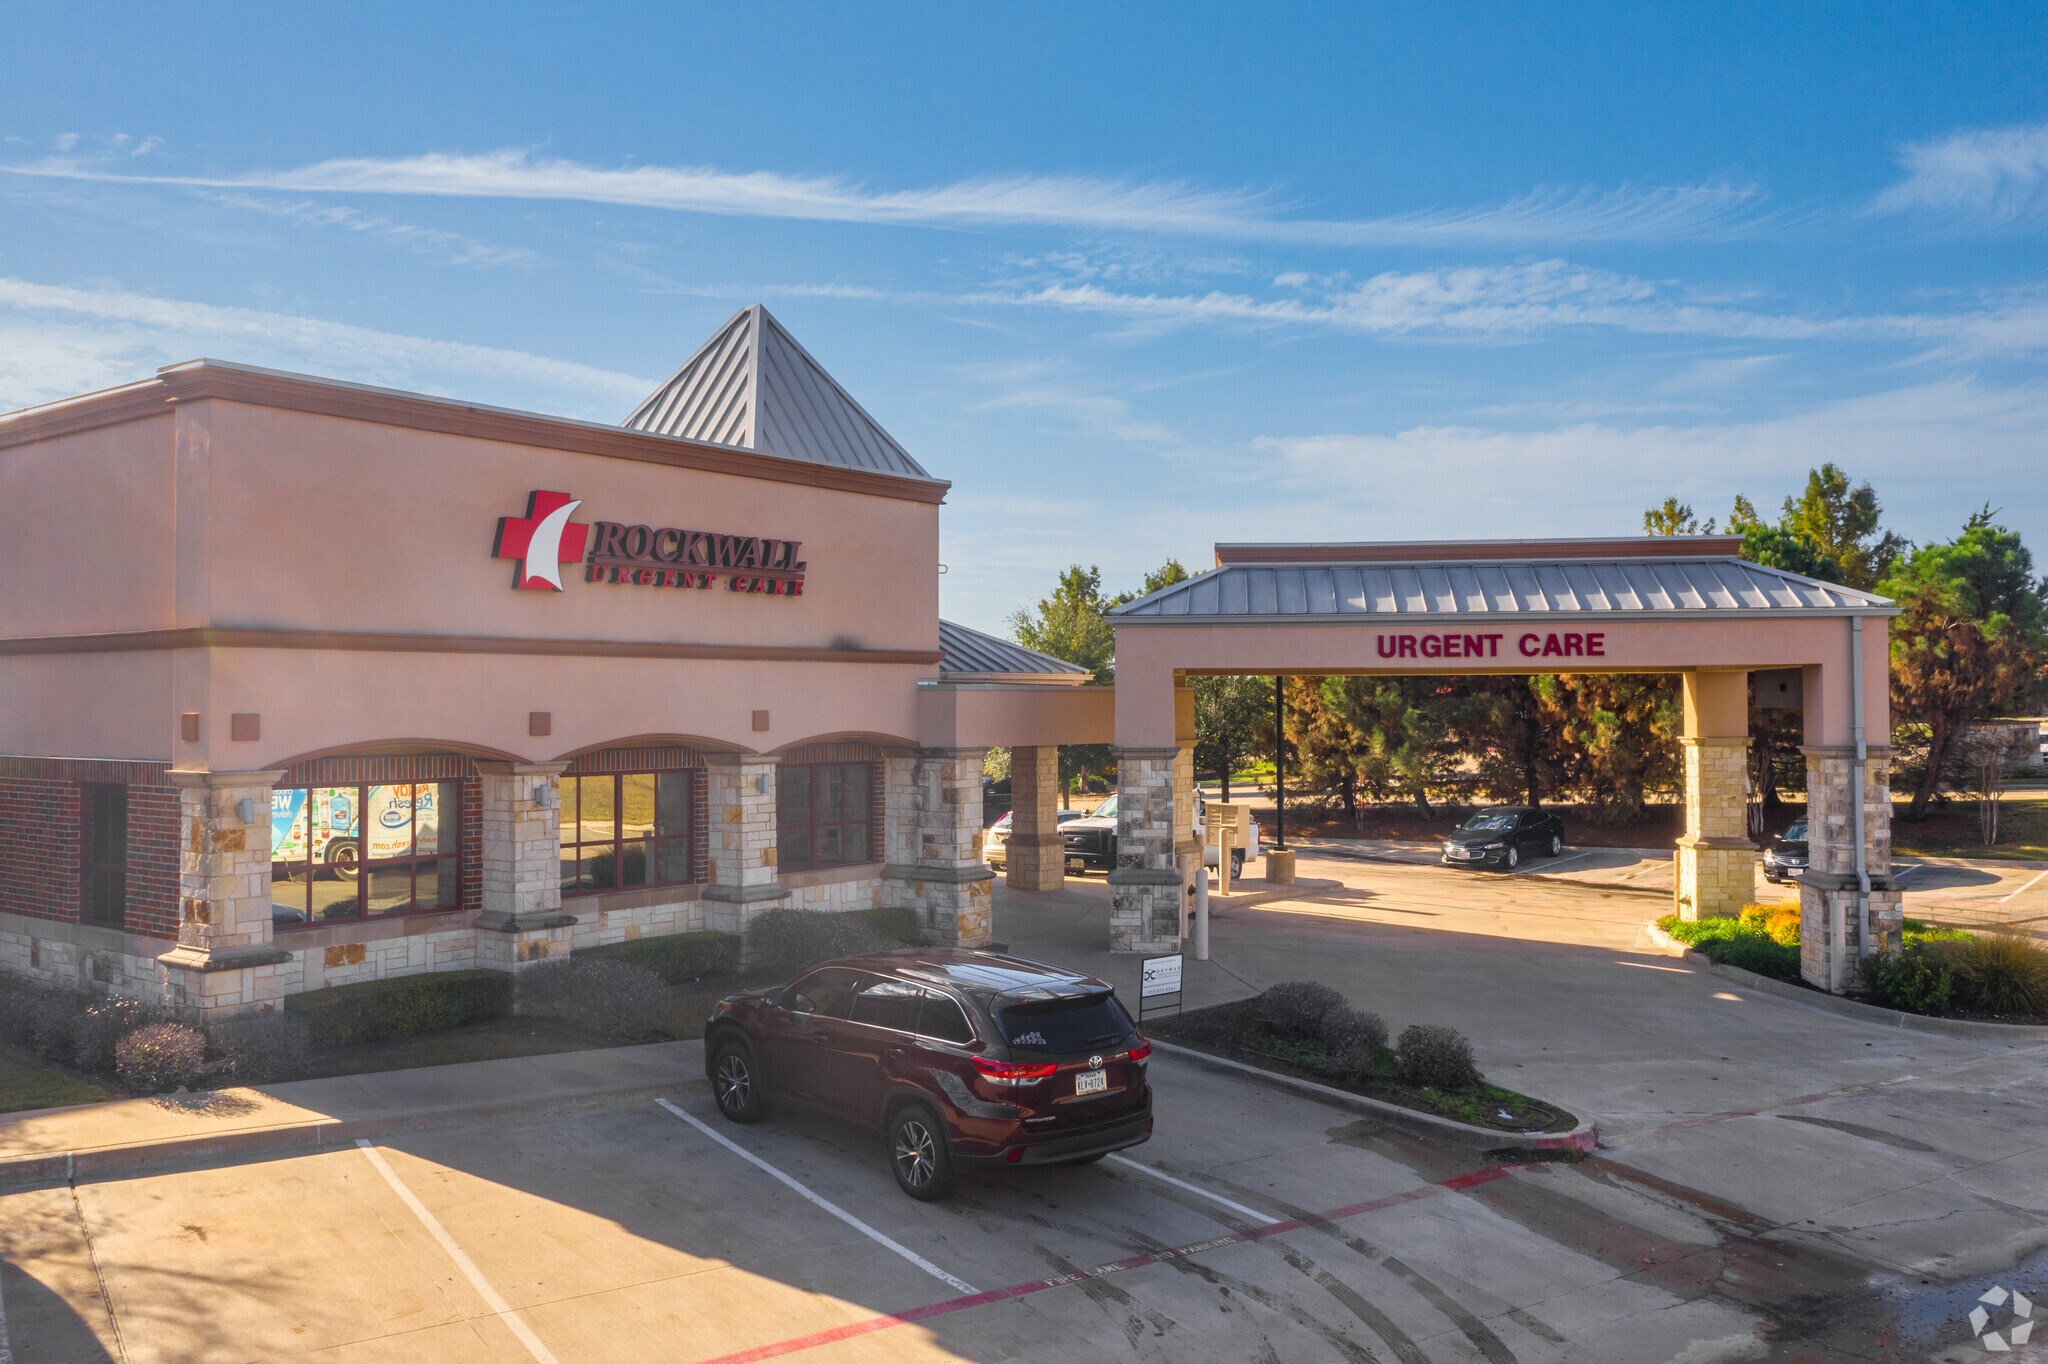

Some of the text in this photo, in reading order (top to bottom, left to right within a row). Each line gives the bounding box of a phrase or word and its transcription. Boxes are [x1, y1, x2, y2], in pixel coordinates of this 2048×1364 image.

[591, 521, 807, 572] ROCKWALL
[588, 565, 804, 596] URGENT CARE
[1377, 633, 1605, 658] URGENT CARE
[1043, 1272, 1082, 1287] FIRE
[1084, 1262, 1126, 1277] LANE
[1179, 1237, 1236, 1255] PARKING
